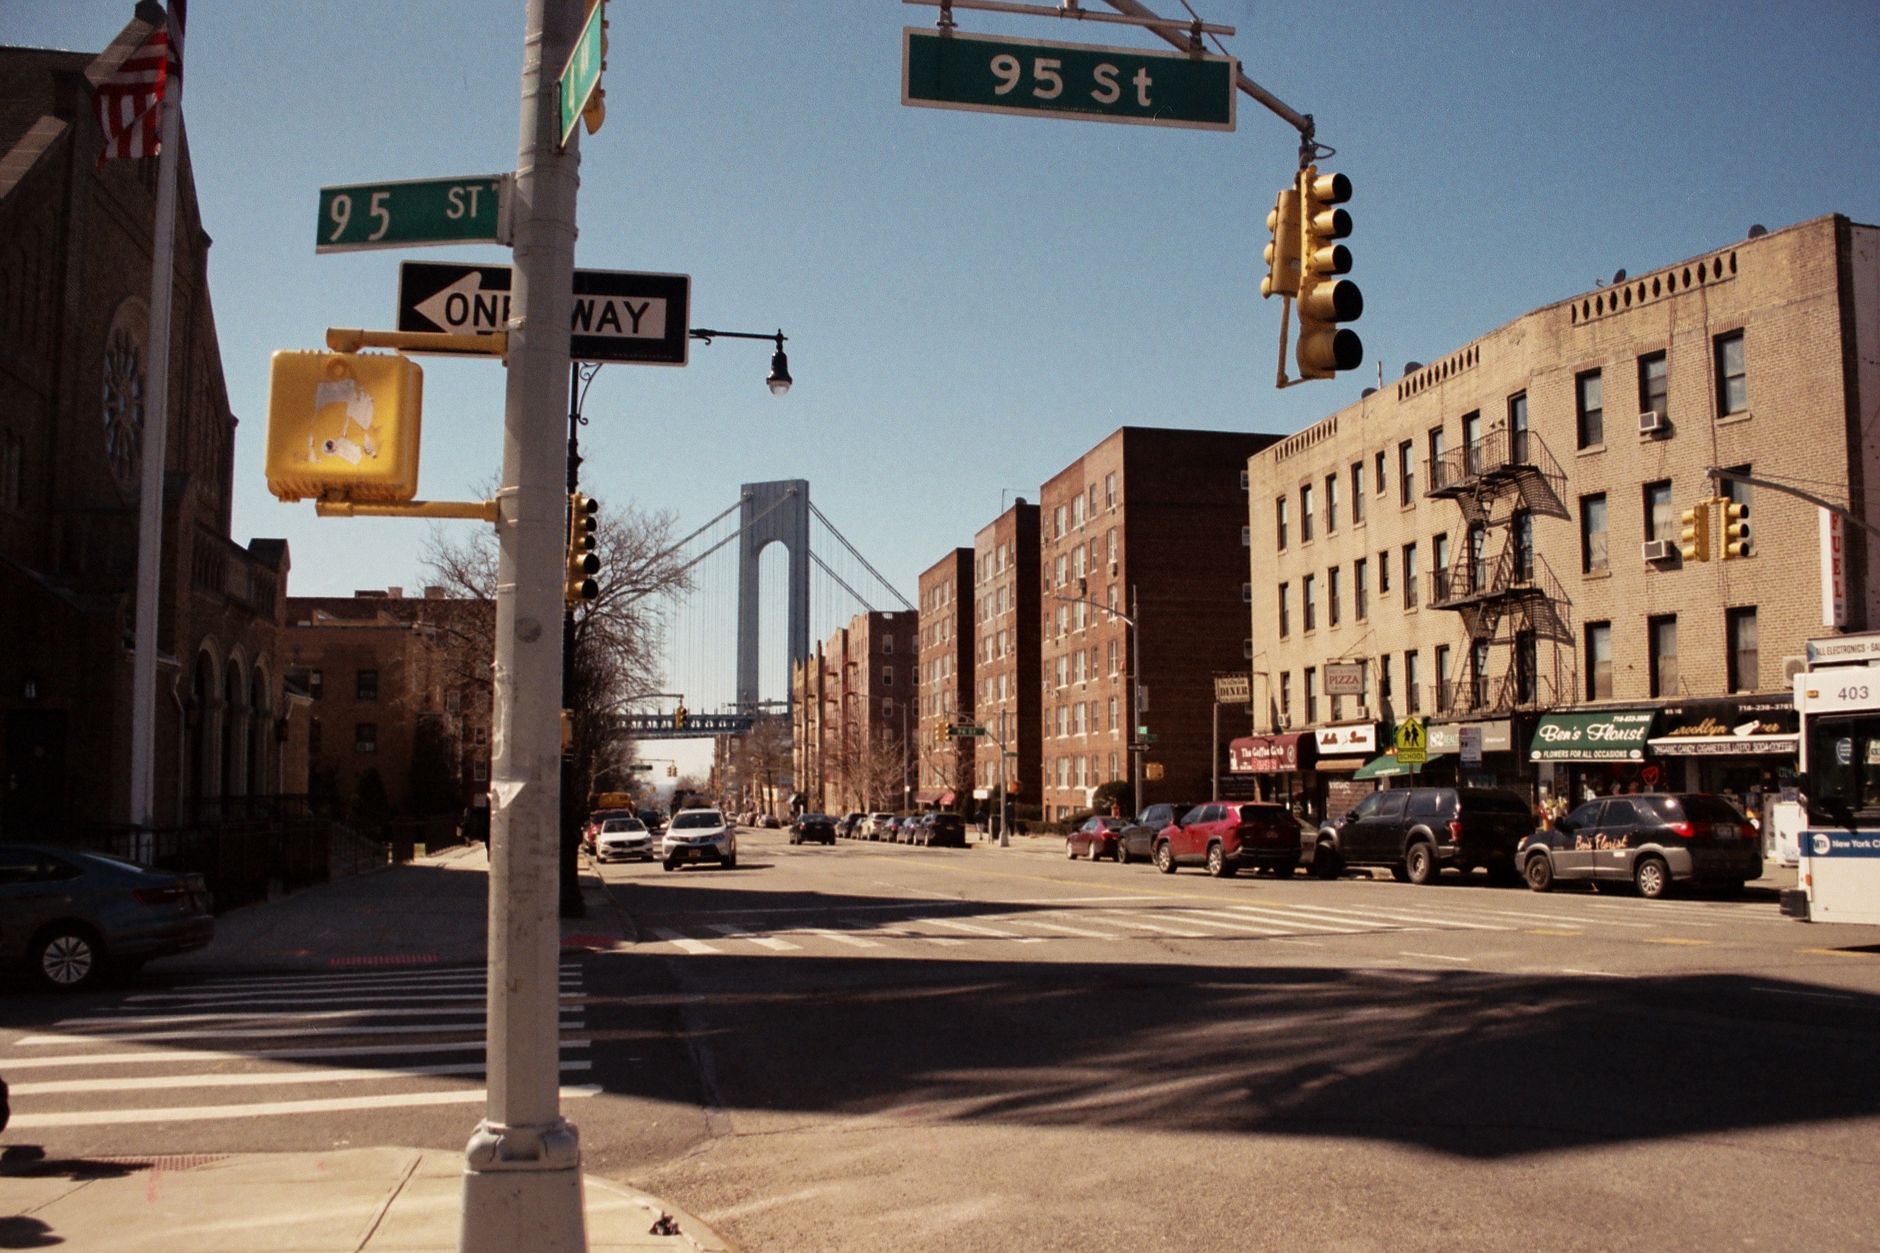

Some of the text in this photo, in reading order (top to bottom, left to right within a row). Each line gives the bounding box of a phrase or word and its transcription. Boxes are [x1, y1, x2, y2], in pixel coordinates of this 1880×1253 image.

[990, 54, 1152, 106] 95 St
[330, 185, 483, 241] 95 ST
[572, 299, 650, 334] WAY
[1827, 644, 1866, 656] ELECTRONICS
[1329, 674, 1359, 684] PIZZA
[1220, 686, 1248, 696] DINER
[1838, 685, 1869, 700] 403
[1539, 723, 1645, 742] Ben's Florist
[1241, 747, 1252, 758] The
[1543, 749, 1628, 758] FLOWERS FOR ALL OCCASIONS
[1678, 744, 1695, 753] CANDY
[1697, 744, 1731, 752] CIGARETTES
[1732, 743, 1750, 751] LOTTO
[1400, 752, 1424, 760] SCHOOL
[1594, 832, 1628, 850] Florist
[1832, 840, 1850, 848] New
[1851, 840, 1871, 848] York
